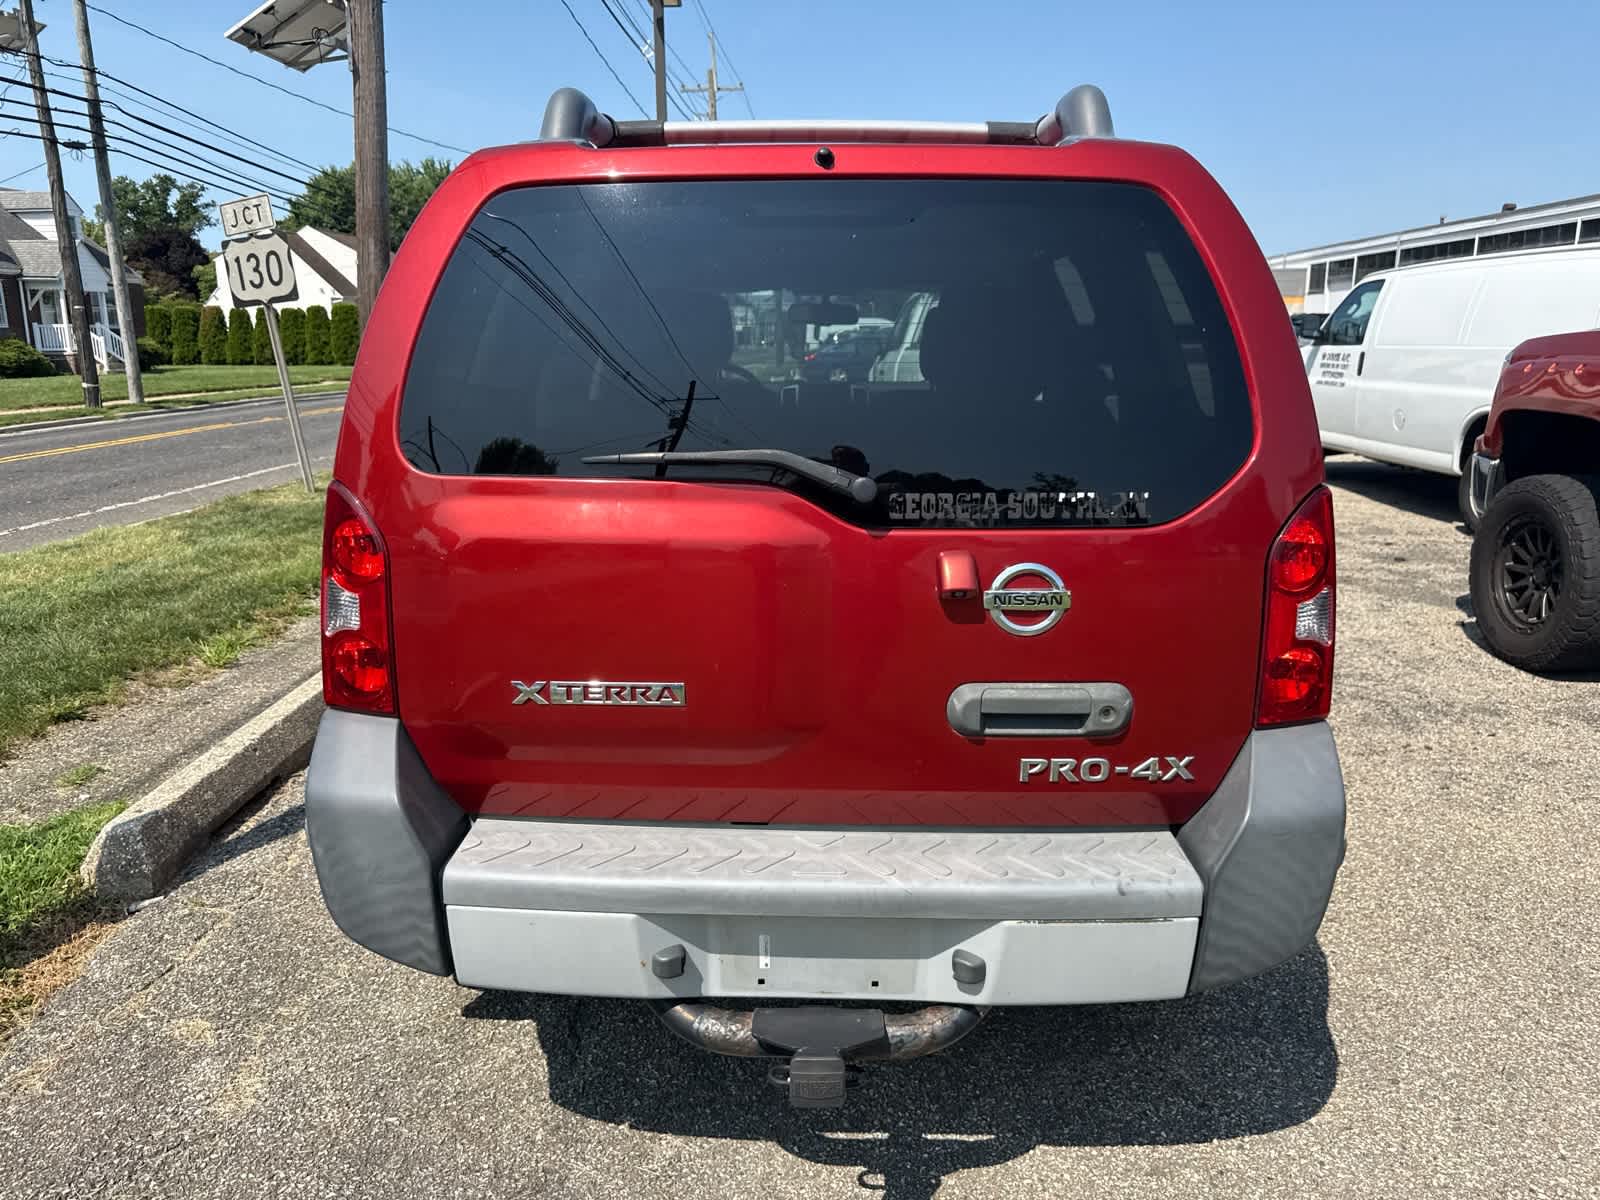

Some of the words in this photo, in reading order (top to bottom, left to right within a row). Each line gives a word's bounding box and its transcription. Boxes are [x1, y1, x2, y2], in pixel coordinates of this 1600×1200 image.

[231, 203, 262, 228] JCT
[234, 250, 284, 291] 130
[888, 491, 1000, 519] GEORGIA
[992, 594, 1064, 606] NISSAN
[511, 680, 686, 706] XTERRA
[1018, 755, 1195, 782] PRO-4X
